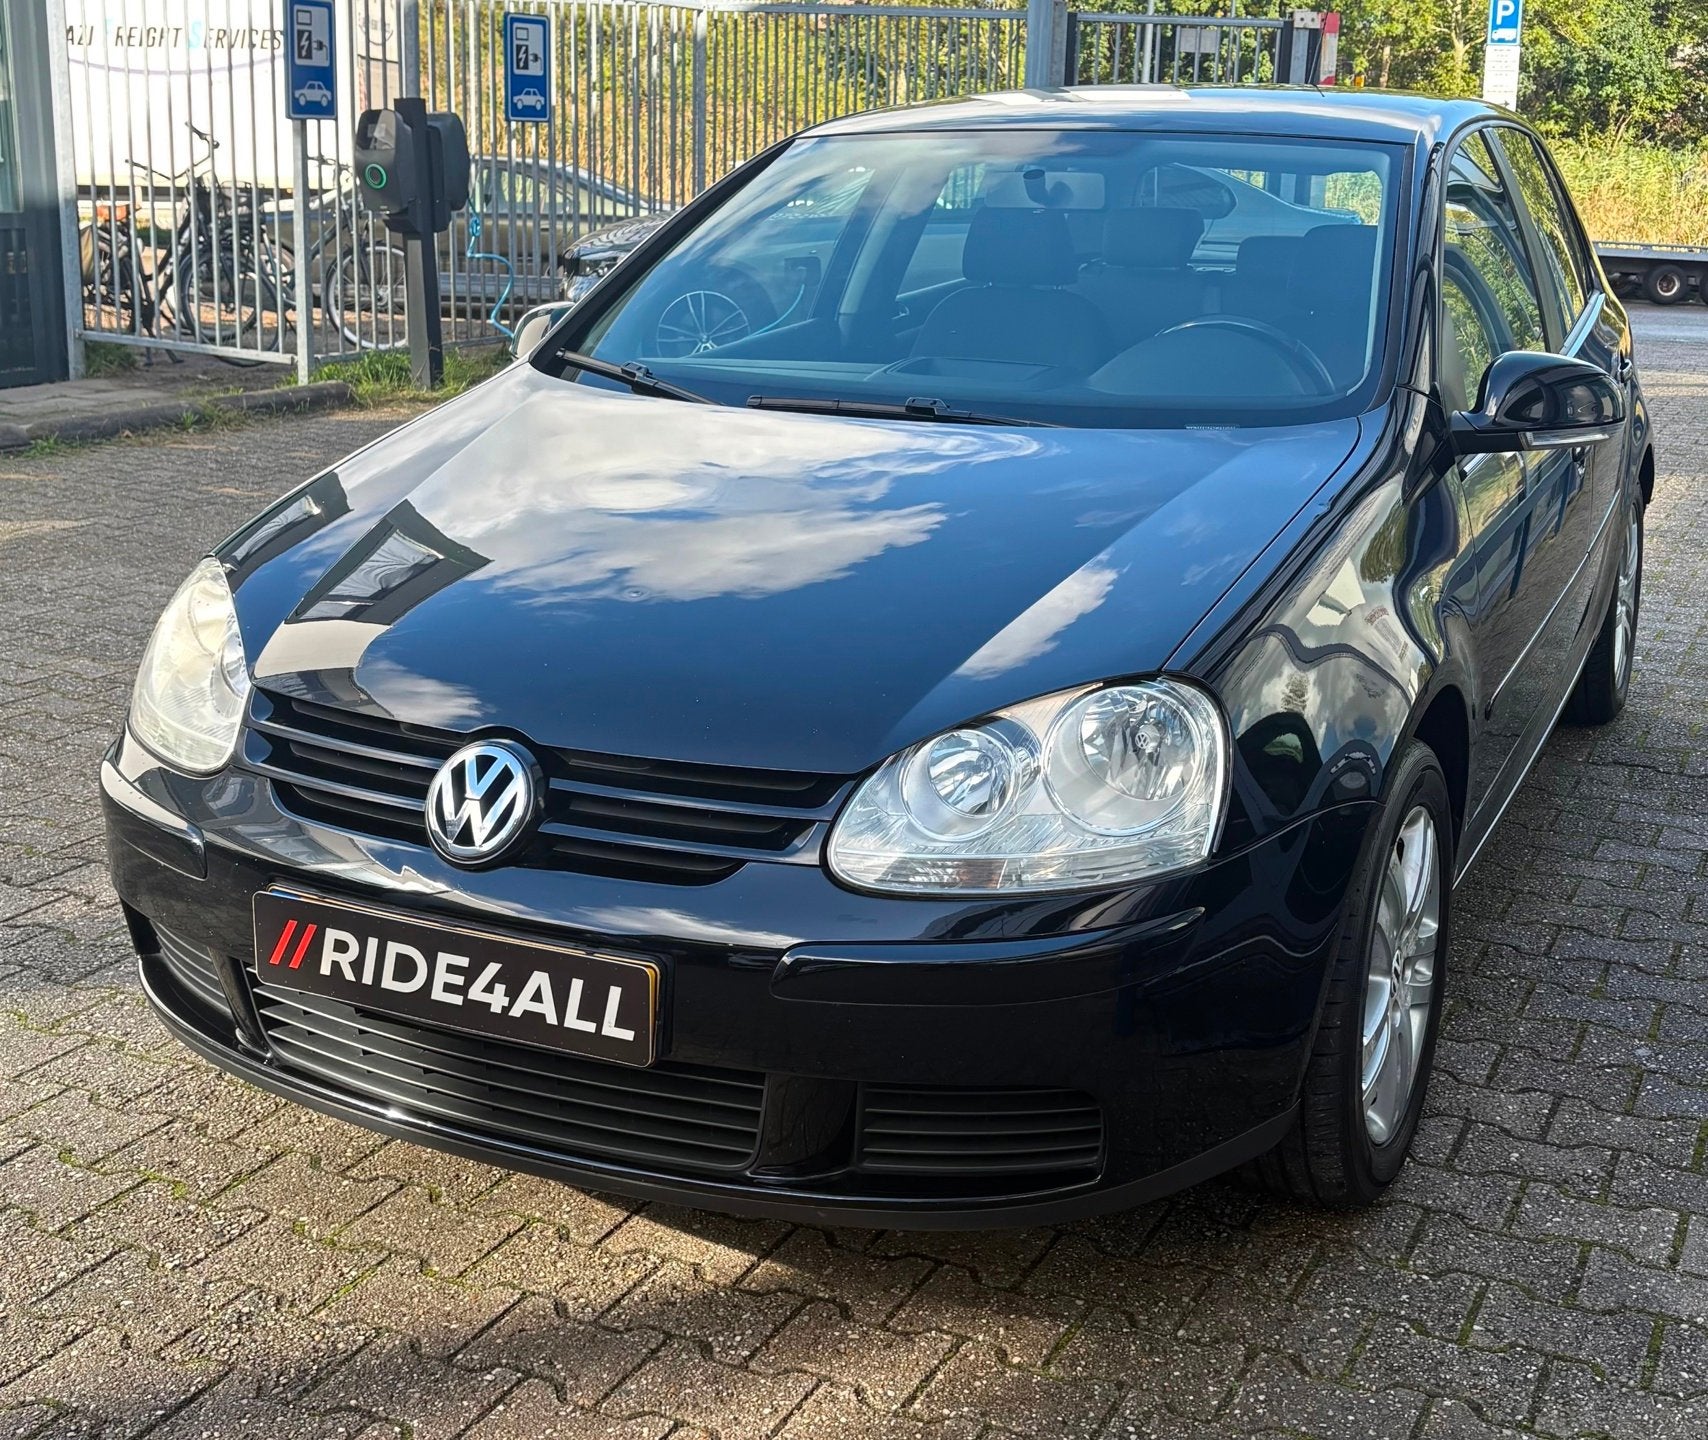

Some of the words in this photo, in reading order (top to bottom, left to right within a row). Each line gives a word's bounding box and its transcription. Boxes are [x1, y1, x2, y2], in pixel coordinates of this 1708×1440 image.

[1496, 0, 1515, 25] P
[188, 19, 284, 50] SERVICES
[427, 742, 532, 860] VW
